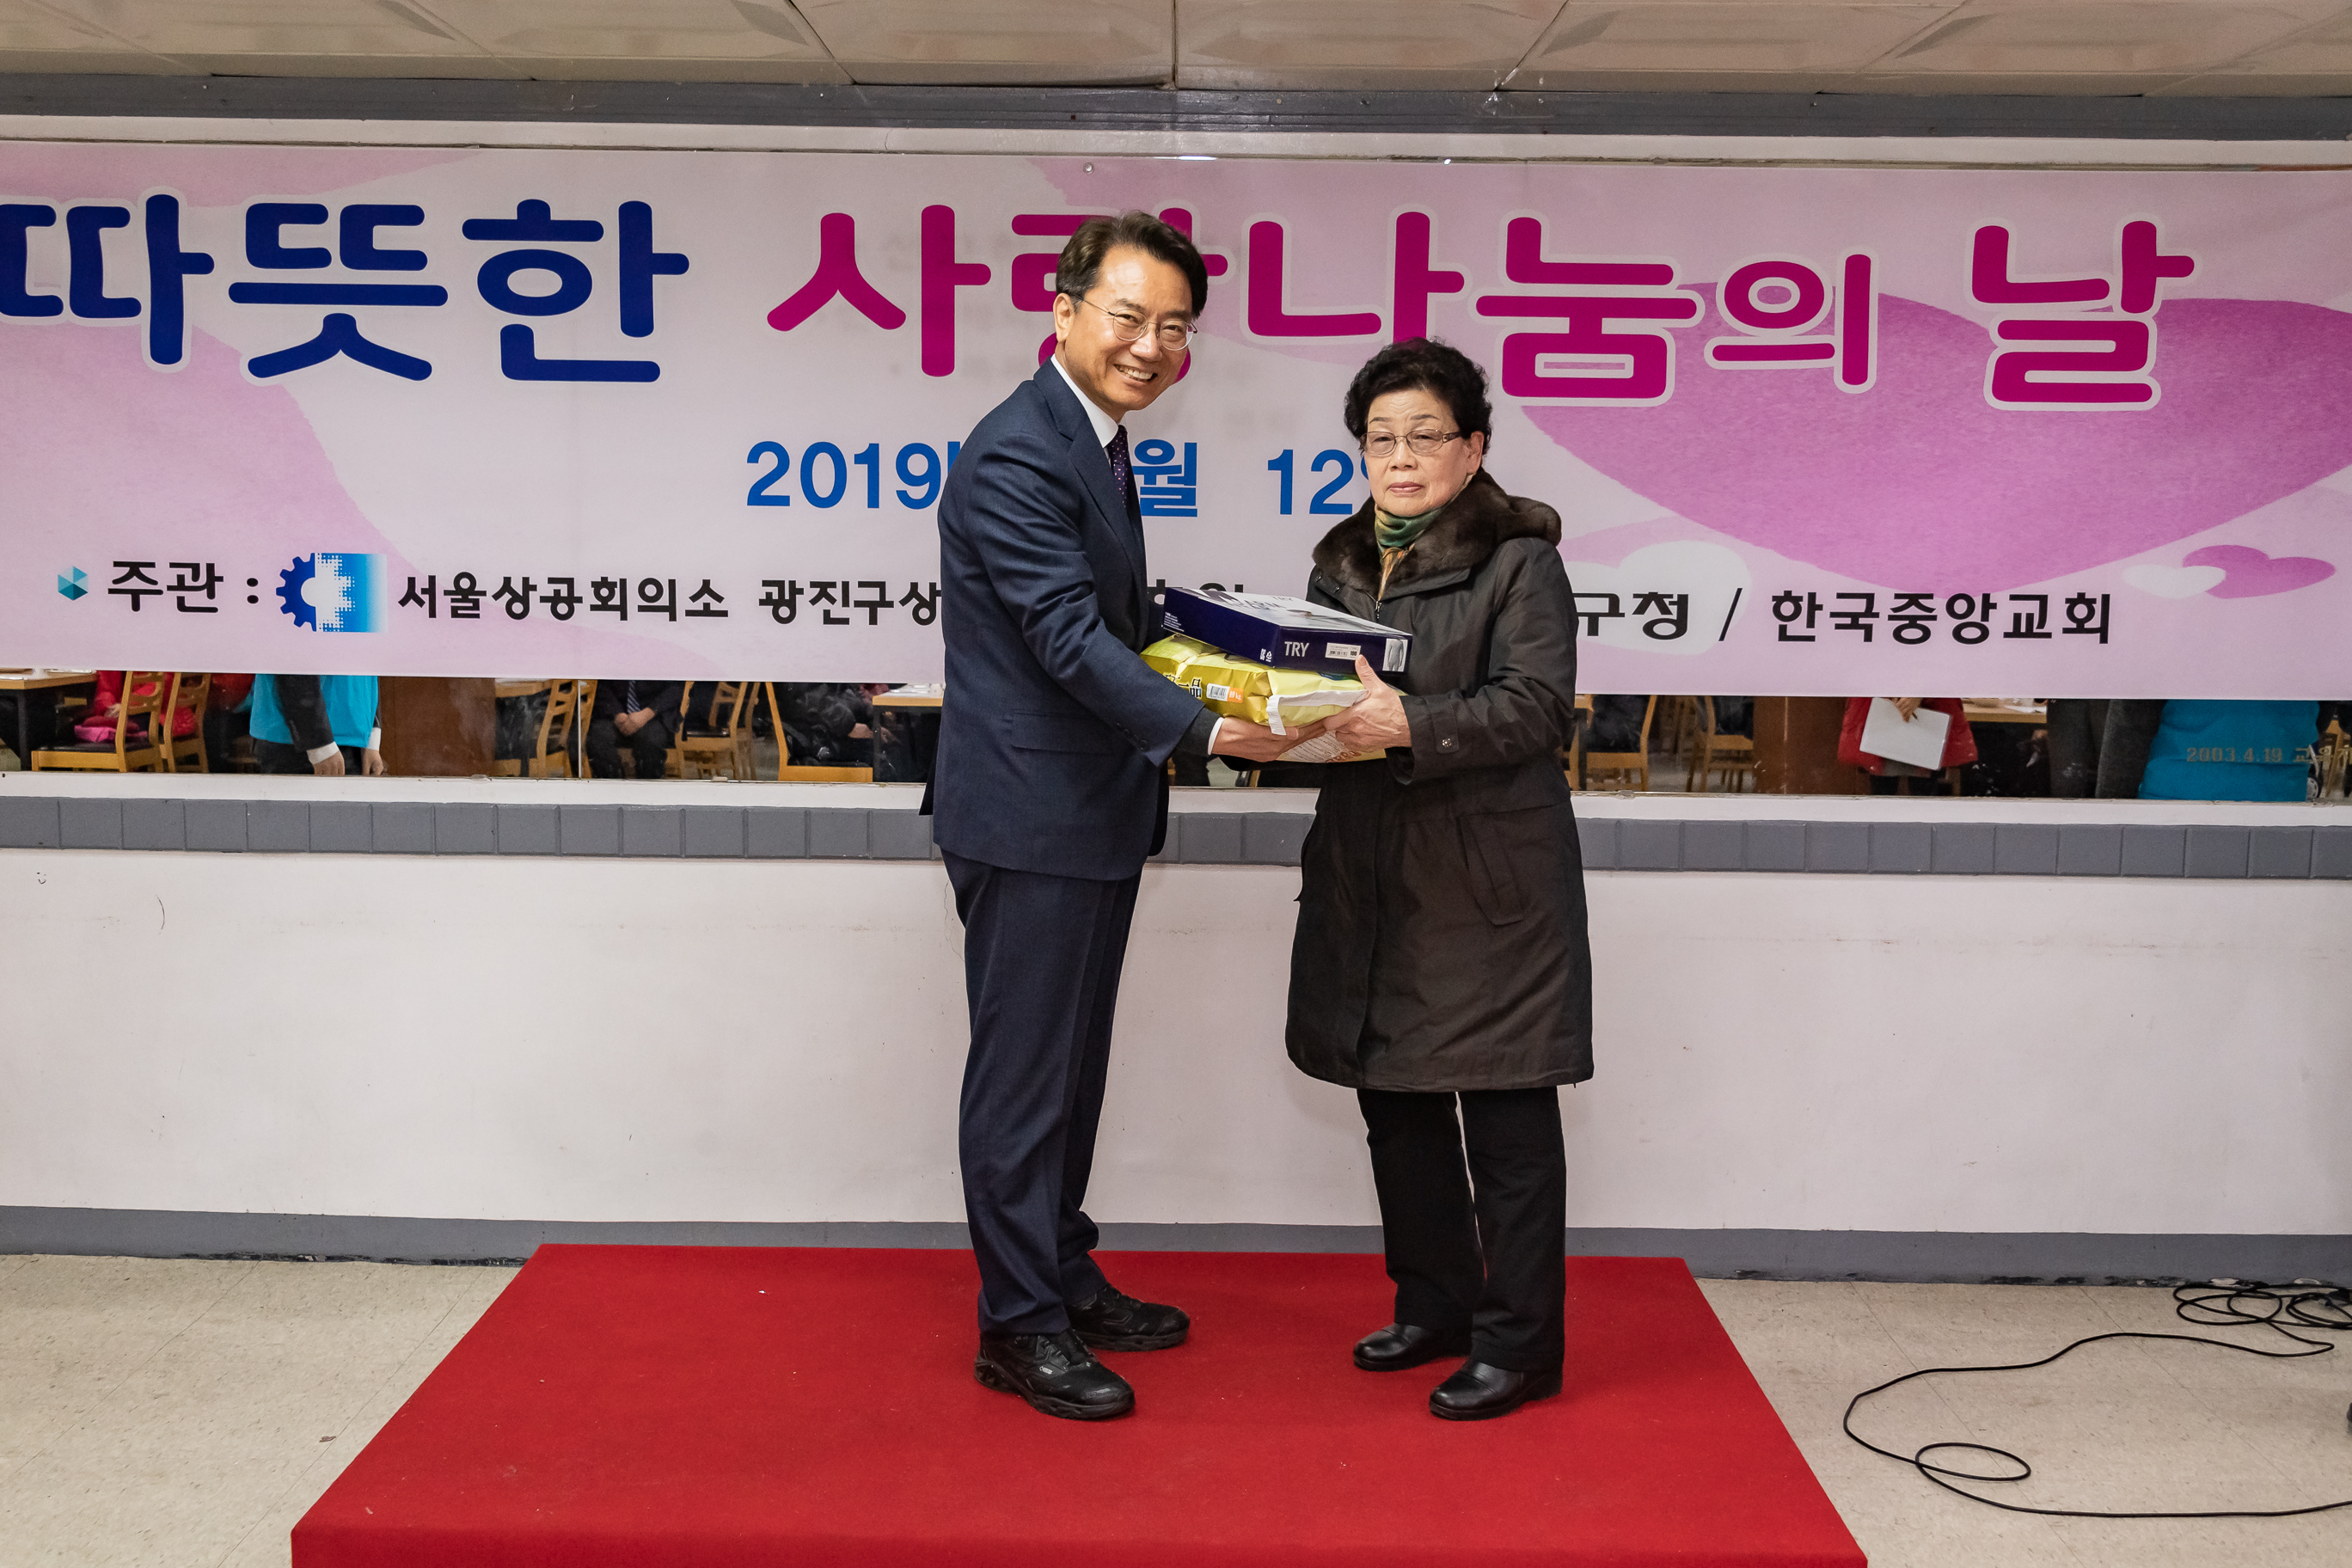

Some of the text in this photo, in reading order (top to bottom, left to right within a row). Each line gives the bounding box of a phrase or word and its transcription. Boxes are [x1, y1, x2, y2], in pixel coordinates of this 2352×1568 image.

[0, 193, 689, 383] 따뜻한
[1973, 221, 2195, 403] 날
[748, 440, 960, 510] 2019
[1268, 449, 1371, 515] 12
[108, 560, 224, 613] 주관
[398, 572, 729, 622] 서울상공회의소
[1773, 590, 2110, 645] 한국중앙교회
[1284, 641, 1309, 657] TRY
[2186, 747, 2282, 763] 2003.4.19
